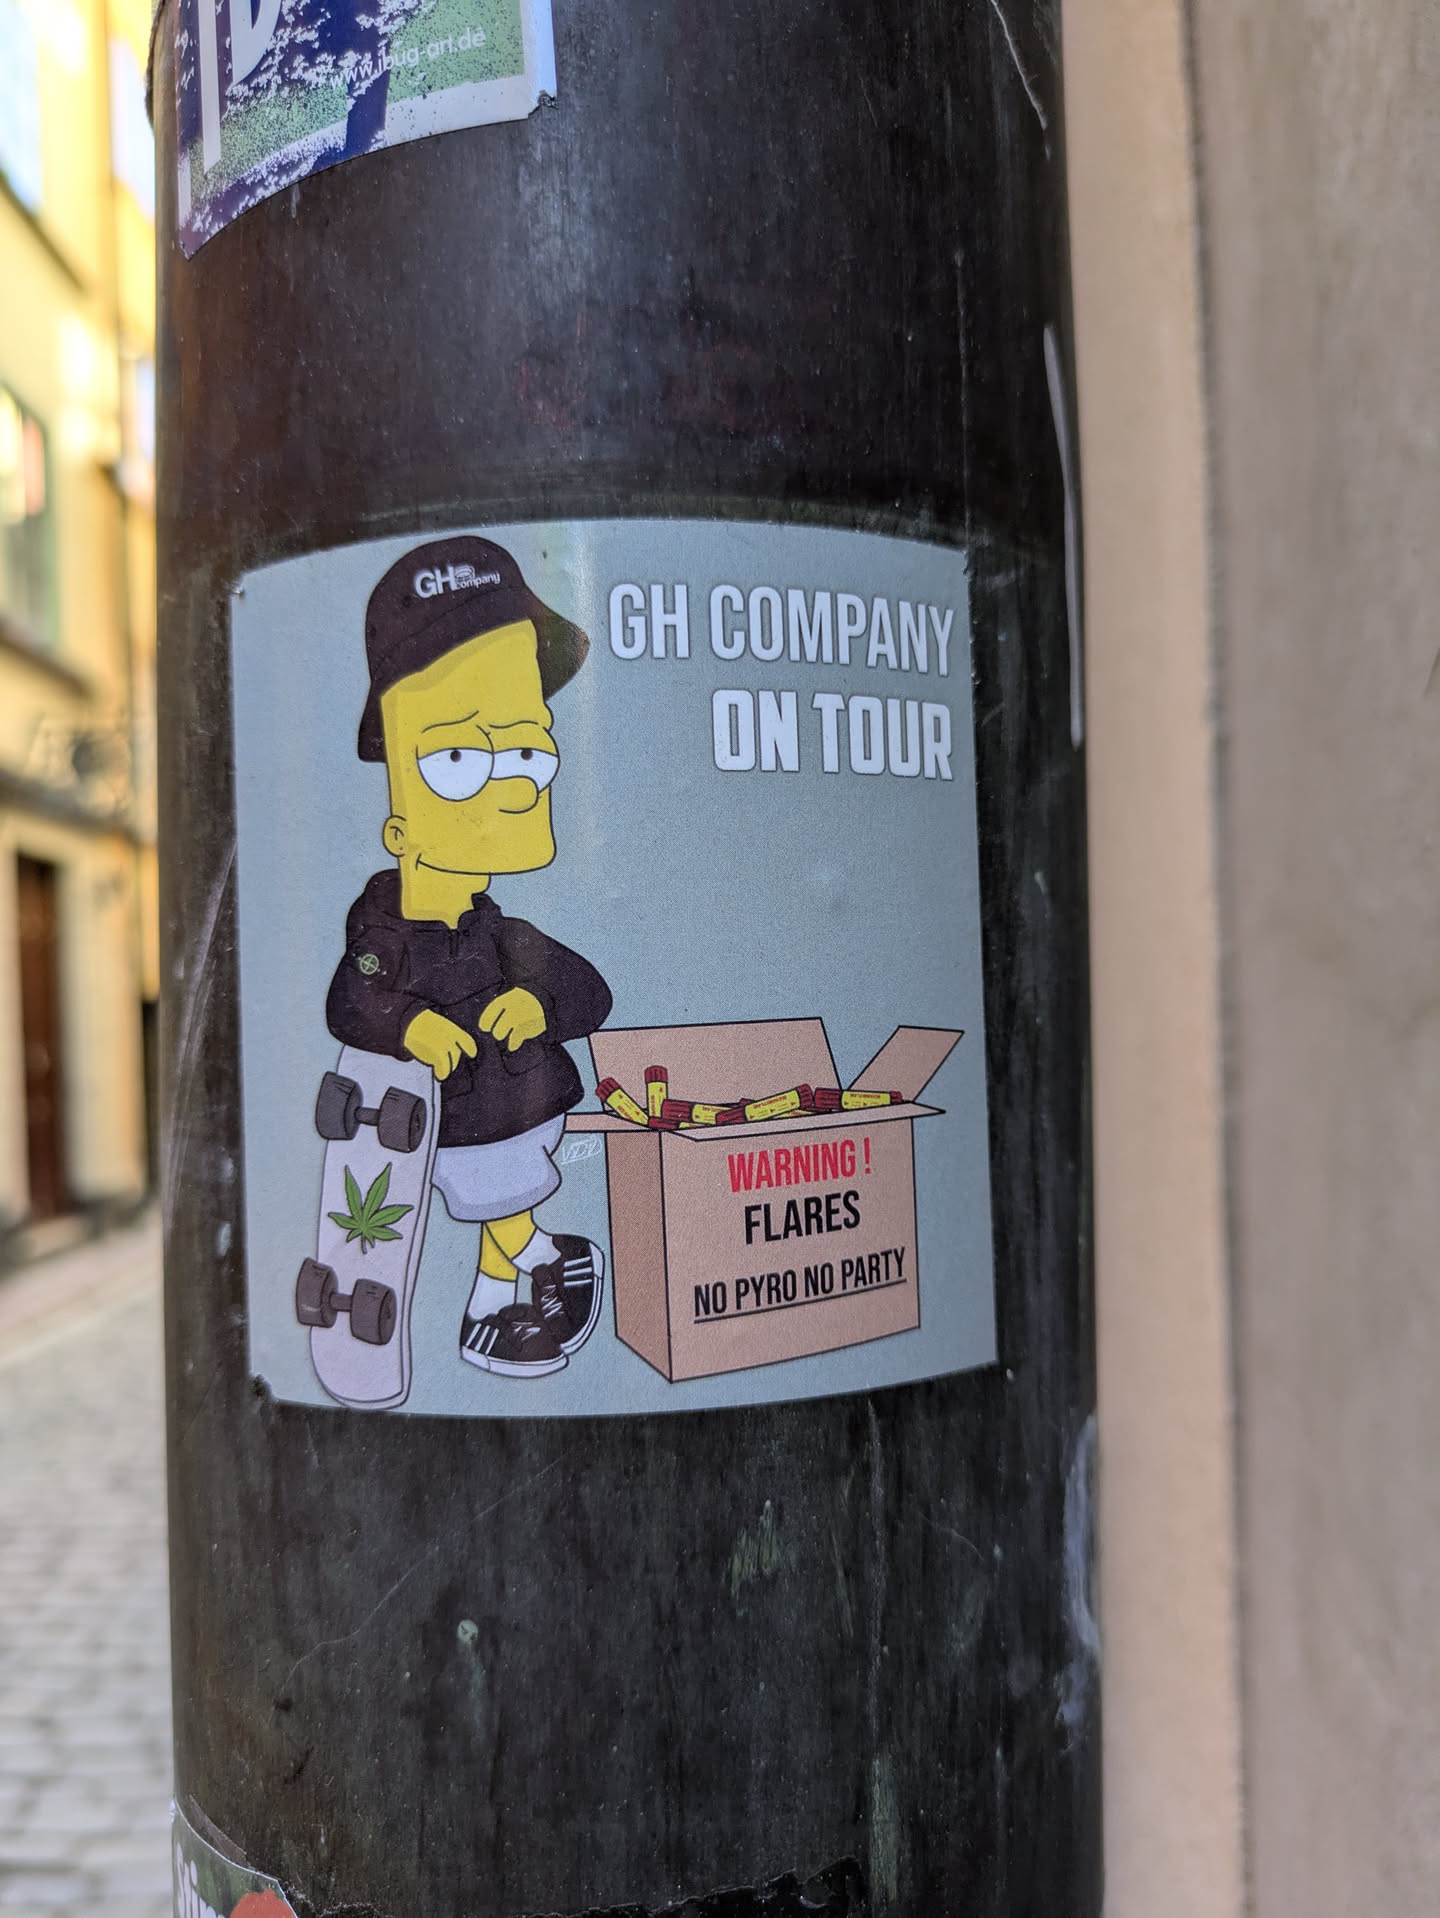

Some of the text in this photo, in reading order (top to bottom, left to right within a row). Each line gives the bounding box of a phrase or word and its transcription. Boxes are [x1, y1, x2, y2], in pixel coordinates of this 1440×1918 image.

[414, 565, 457, 598] GH
[608, 583, 954, 677] GH COMPANY
[712, 688, 953, 781] ON TOUR
[727, 1139, 856, 1192] WARNING
[744, 1190, 861, 1245] FLARES
[694, 1246, 906, 1317] NO PYRO NO PARTY
